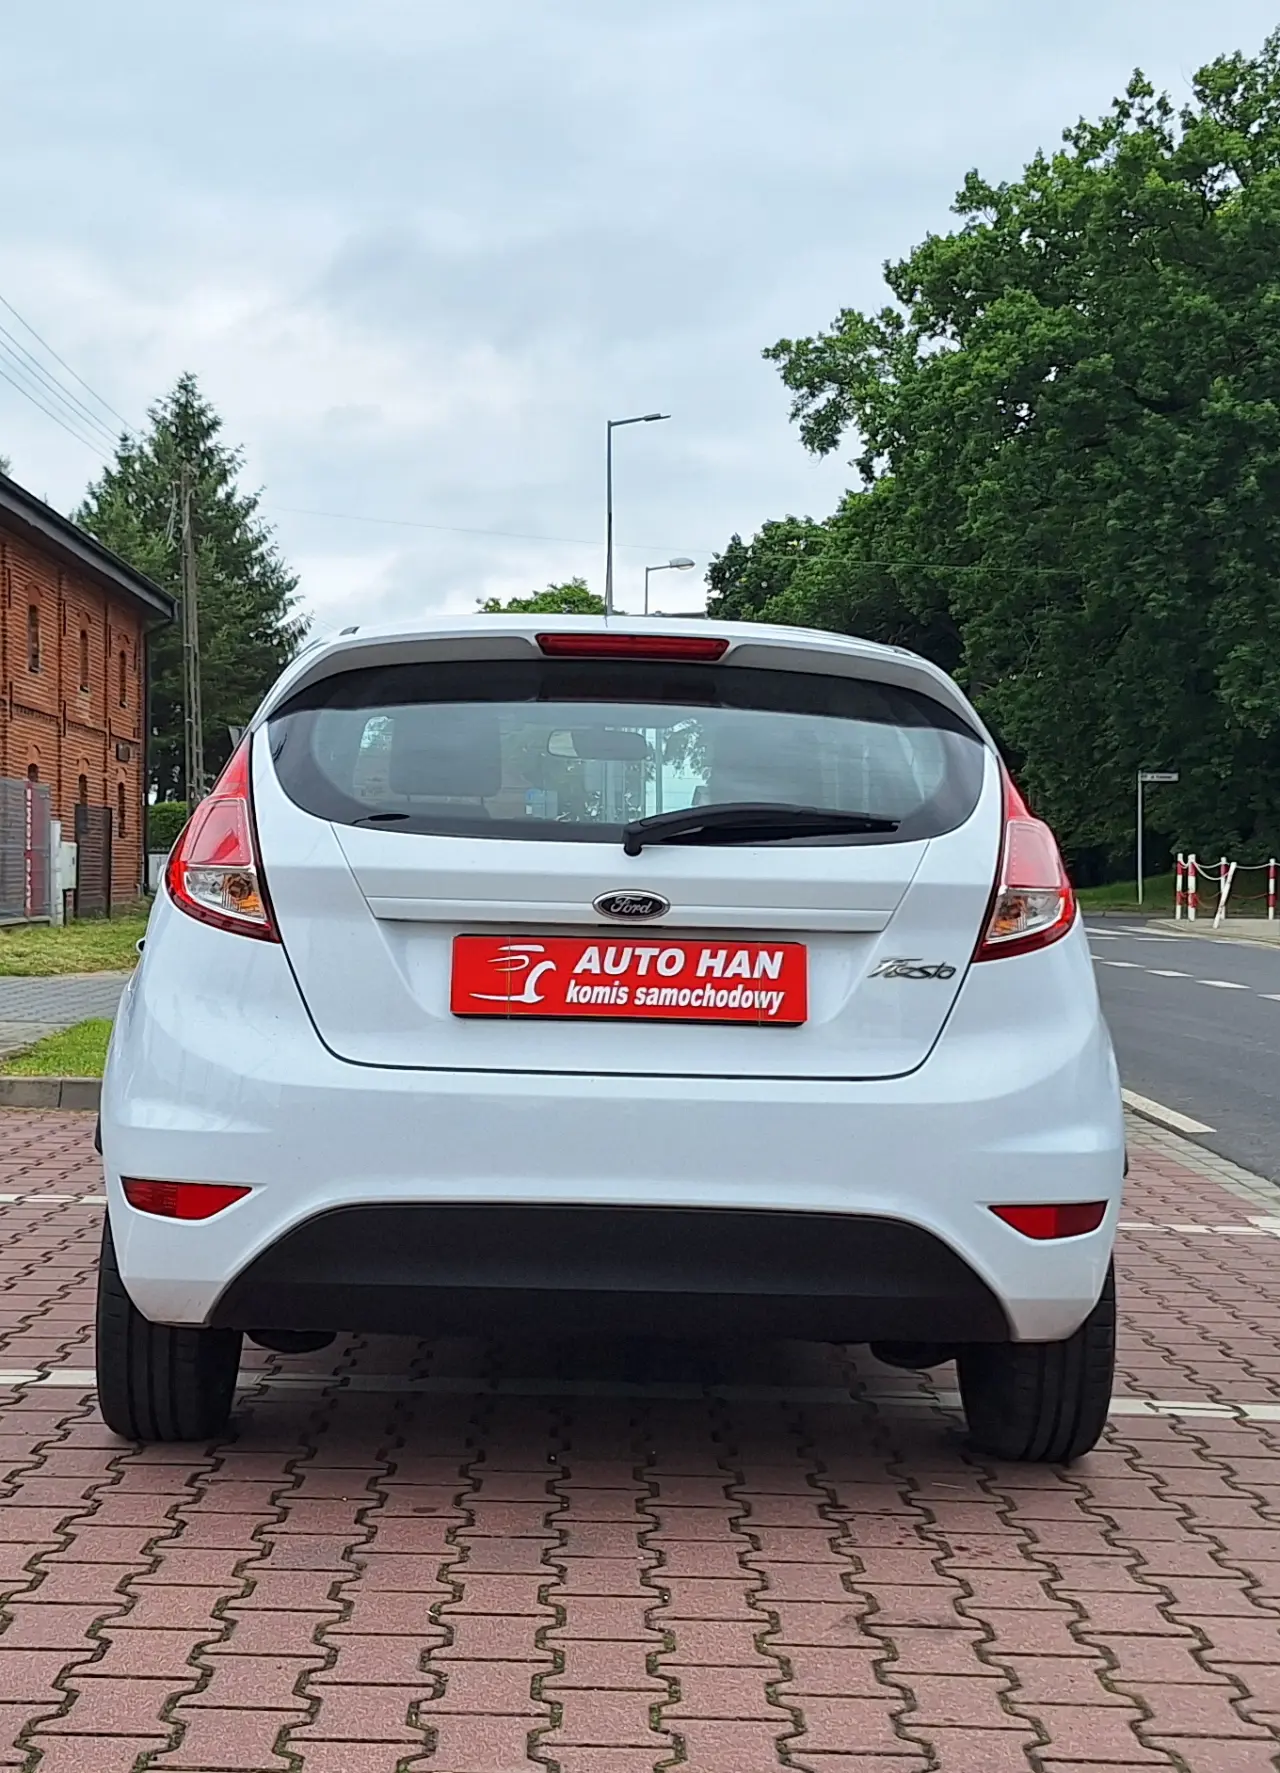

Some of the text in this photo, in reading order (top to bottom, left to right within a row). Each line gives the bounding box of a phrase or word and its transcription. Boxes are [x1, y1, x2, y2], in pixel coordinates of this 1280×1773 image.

[610, 896, 652, 915] Ford
[573, 946, 784, 979] AUTO HAN
[867, 957, 956, 980] Fiesta
[565, 980, 785, 1015] komis samochodowy
